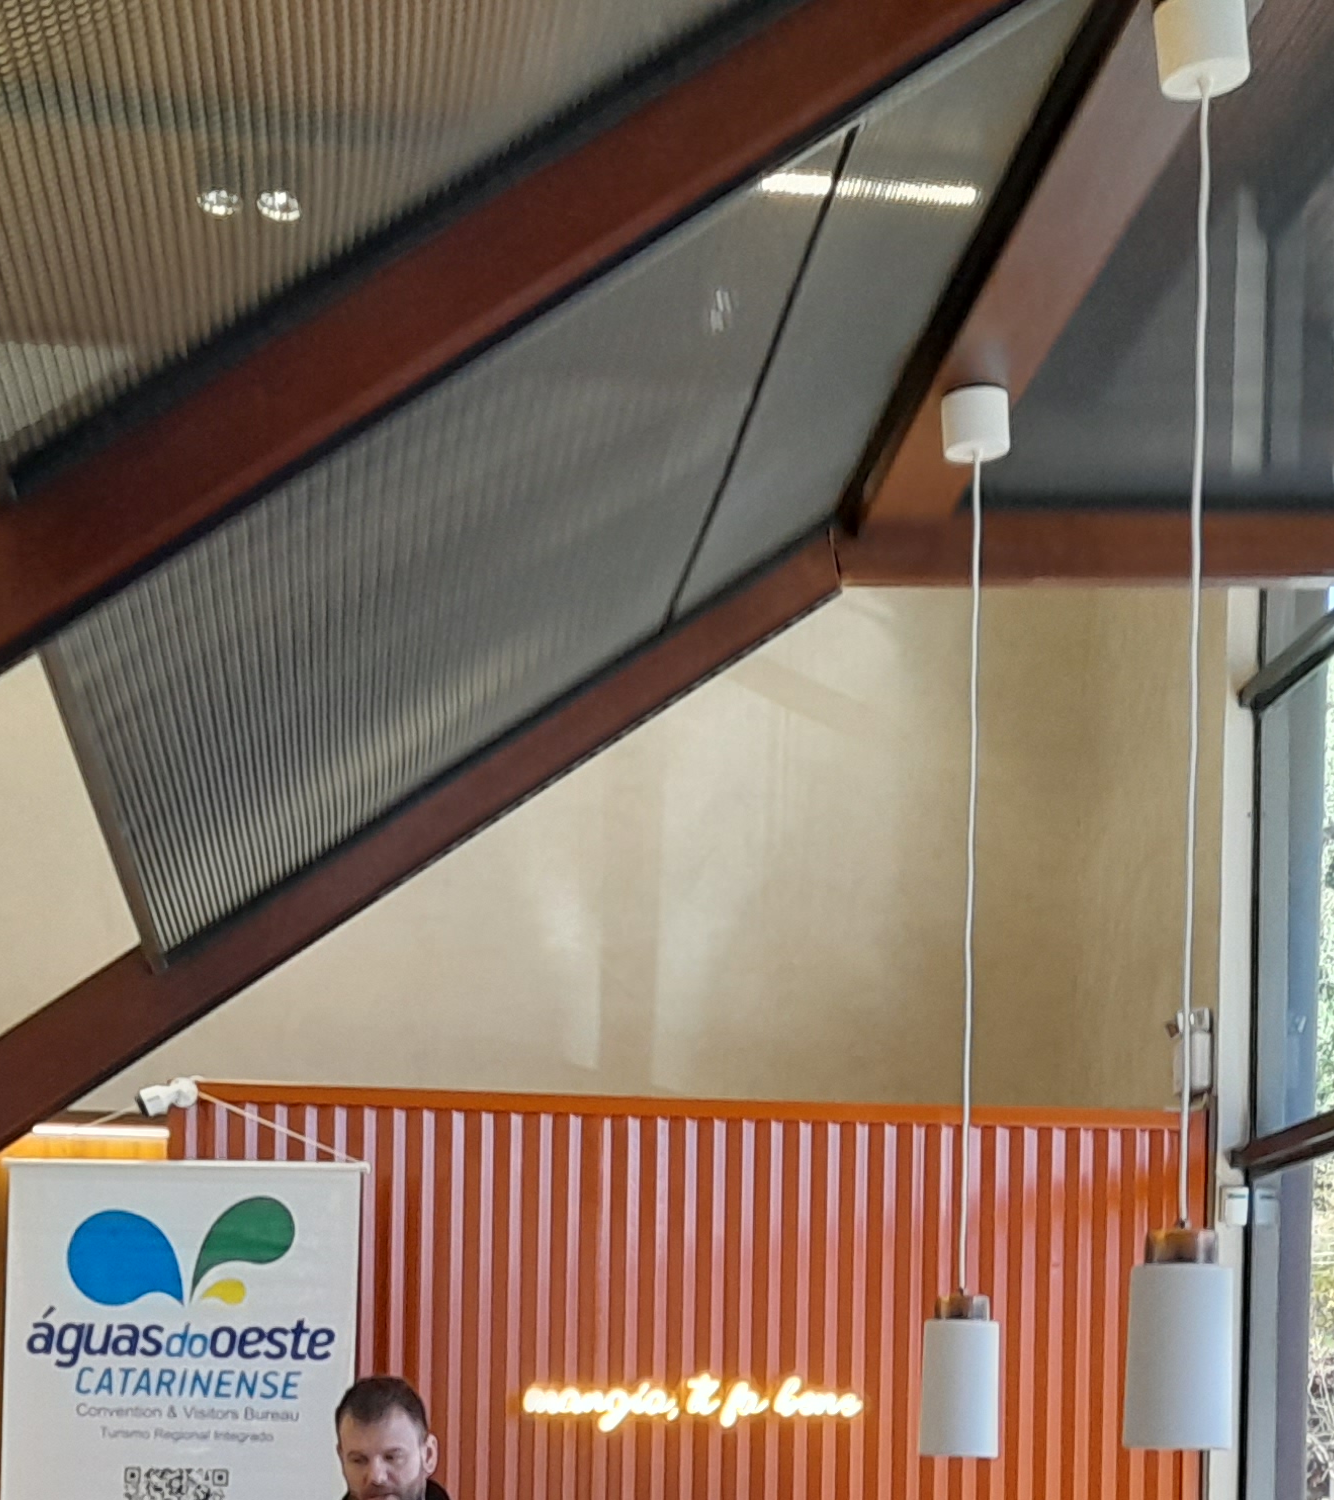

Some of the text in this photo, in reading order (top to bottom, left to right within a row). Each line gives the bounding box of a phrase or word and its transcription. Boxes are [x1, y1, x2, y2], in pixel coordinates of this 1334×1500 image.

[75, 1367, 303, 1399] CATARINENSE
[76, 1402, 300, 1423] Convention & Visitors Bureau
[99, 1425, 275, 1444] Turismo Regional Integrado
